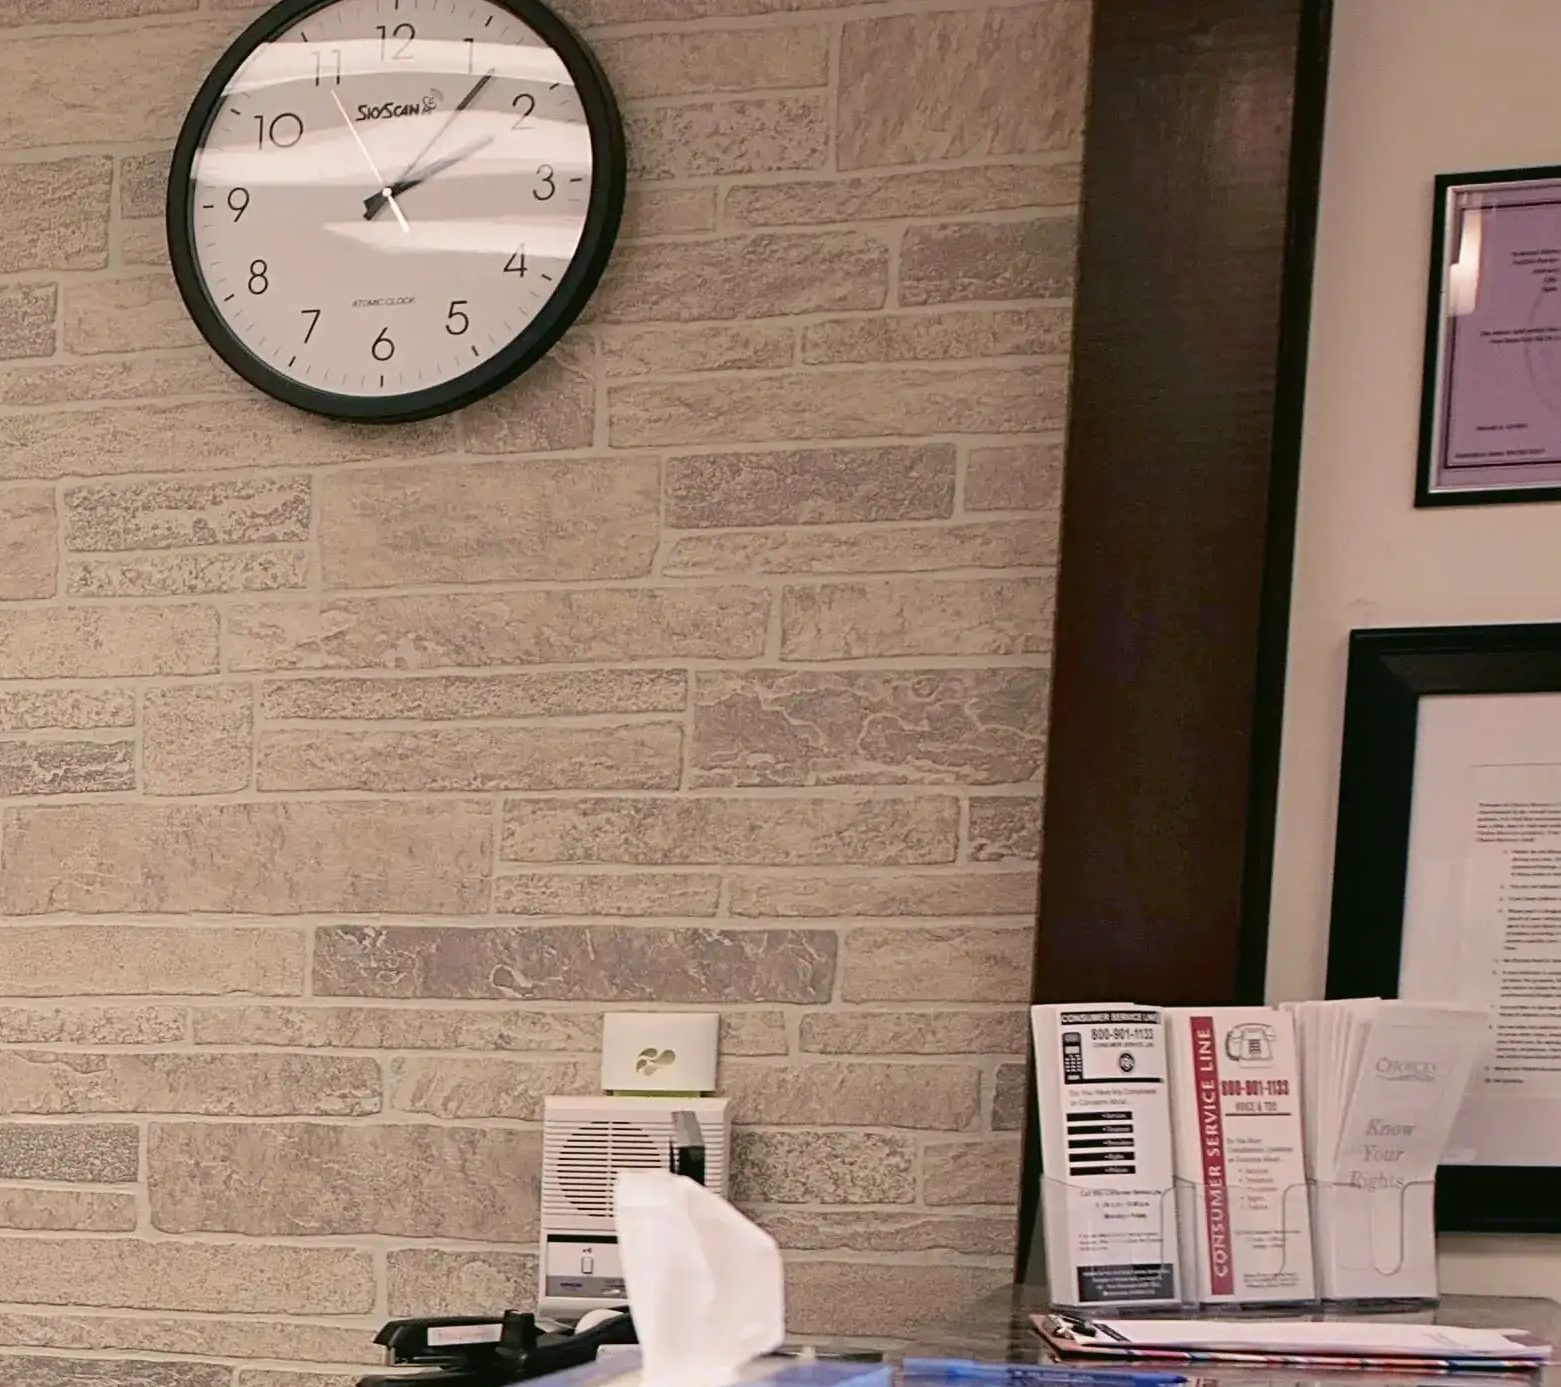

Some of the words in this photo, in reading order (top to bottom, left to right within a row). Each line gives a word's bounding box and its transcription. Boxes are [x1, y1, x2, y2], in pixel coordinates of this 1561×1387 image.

[376, 23, 416, 62] 12
[463, 37, 475, 75] 1
[312, 49, 342, 87] 11
[511, 93, 536, 131] 2
[253, 112, 304, 151] 10
[532, 163, 556, 202] 3
[227, 187, 250, 223] 9
[248, 260, 269, 295] 8
[503, 243, 528, 278] 4
[384, 296, 416, 306] CLOCK
[445, 300, 470, 336] 5
[301, 309, 322, 344] 7
[371, 327, 395, 361] 6
[1197, 1028, 1216, 1072] LINE
[1200, 1079, 1222, 1157] SERVICE
[1366, 1118, 1417, 1137] Know
[1363, 1144, 1405, 1163] Your
[1350, 1170, 1405, 1193] Rights
[1208, 1164, 1230, 1278] CONSUMER
